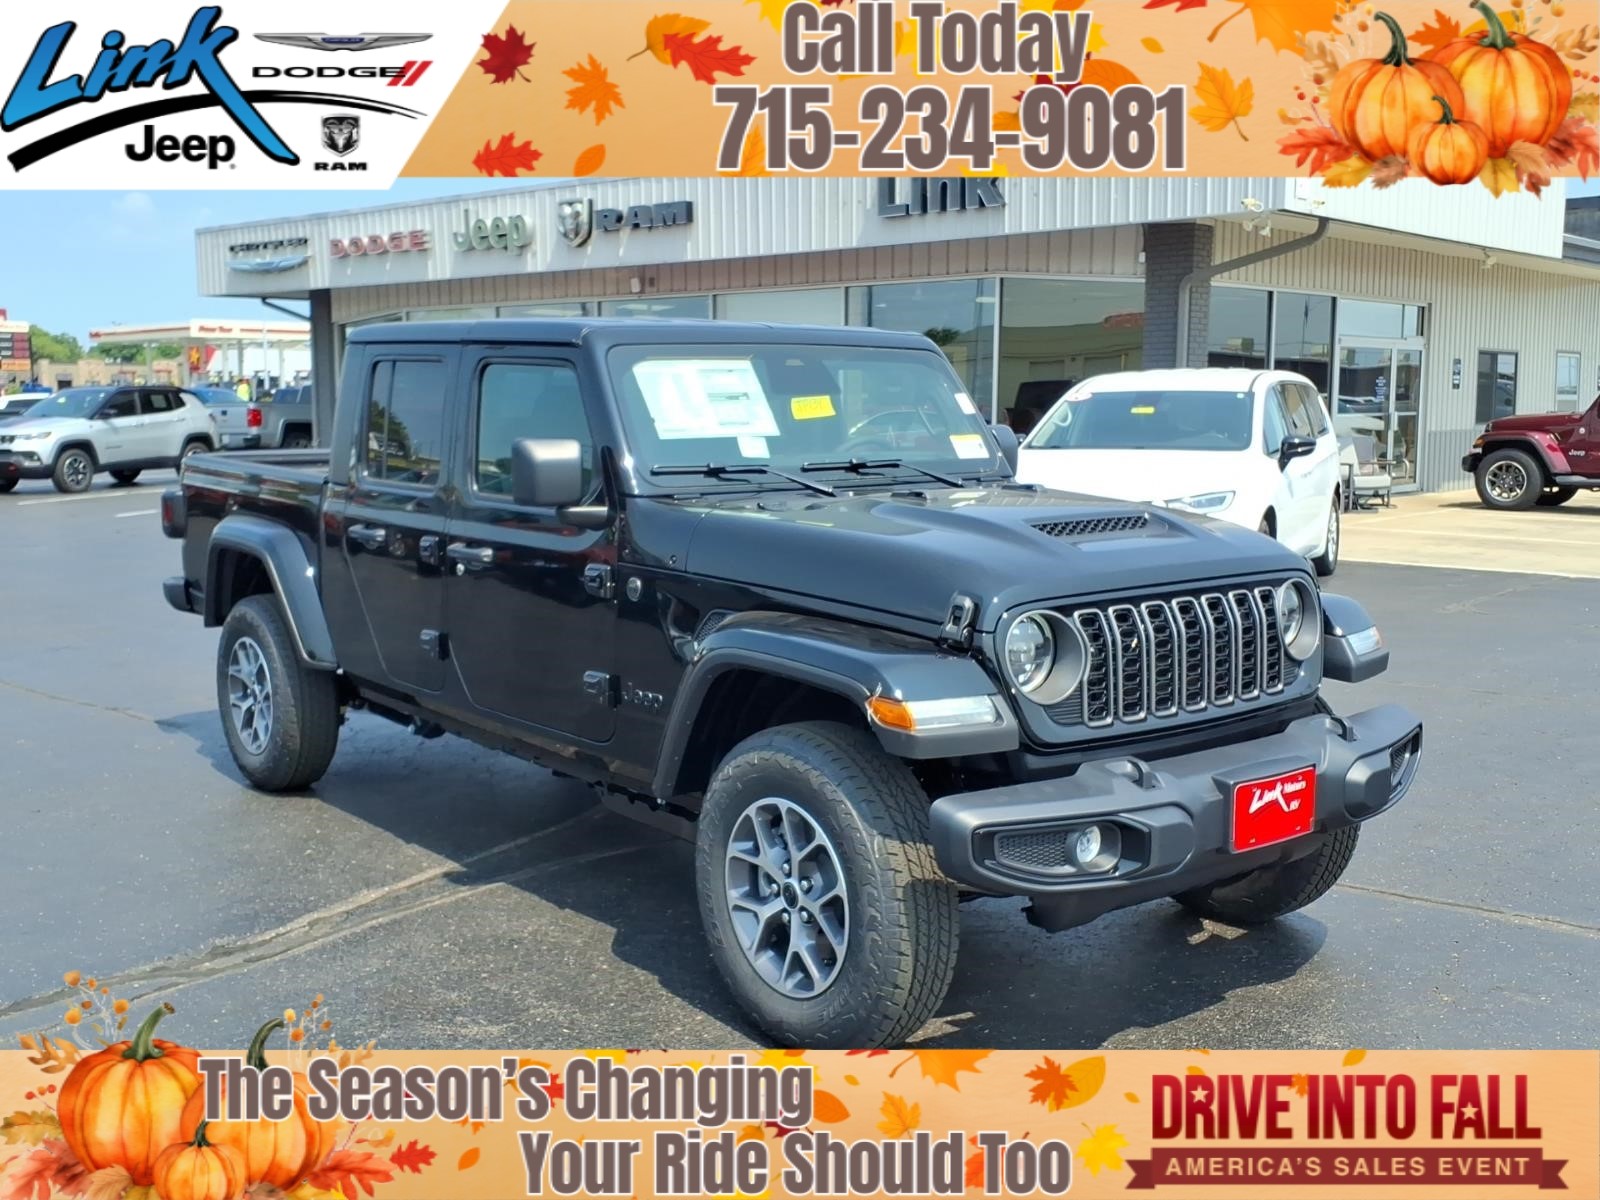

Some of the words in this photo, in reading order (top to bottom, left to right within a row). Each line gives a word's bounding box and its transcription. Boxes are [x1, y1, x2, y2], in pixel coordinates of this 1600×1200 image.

[452, 208, 532, 256] Jeep
[595, 201, 693, 232] RAM
[329, 229, 430, 258] DODGE
